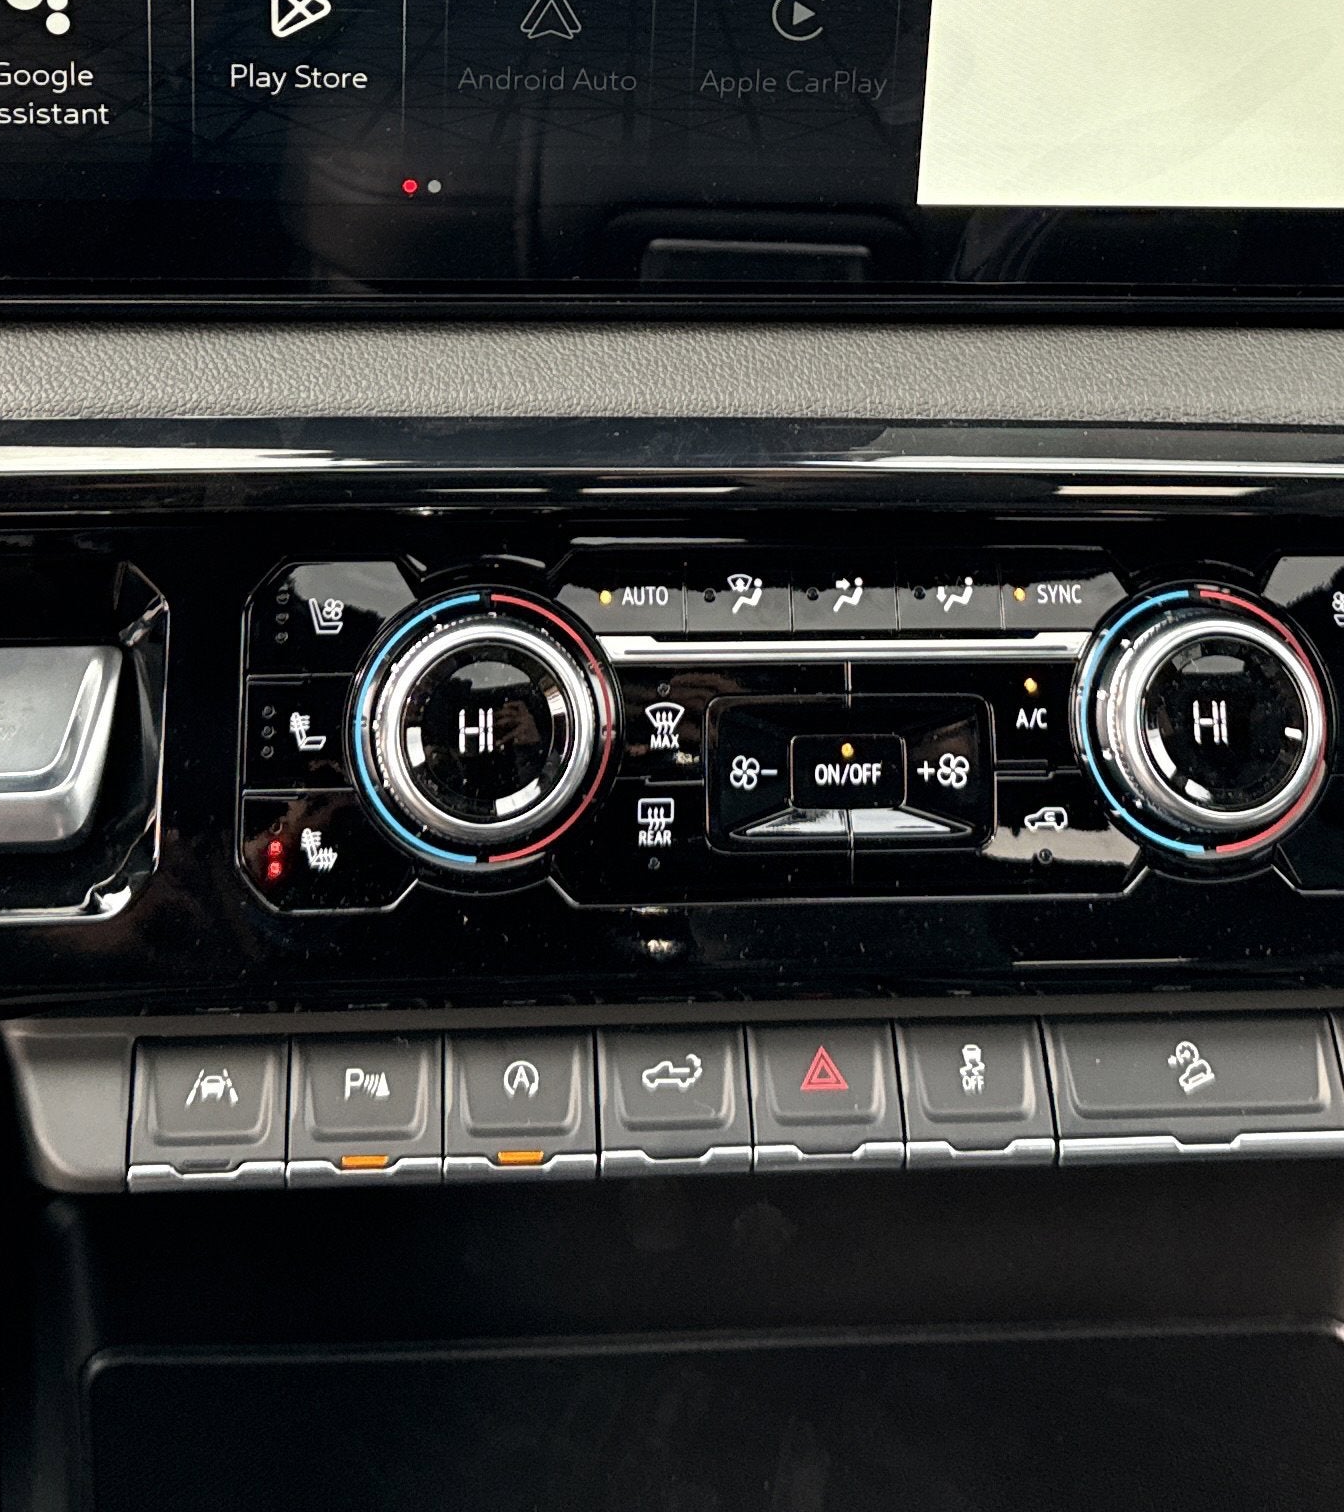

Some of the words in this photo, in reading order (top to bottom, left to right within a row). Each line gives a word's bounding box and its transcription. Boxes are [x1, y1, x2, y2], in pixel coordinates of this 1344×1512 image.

[230, 64, 287, 92] Play
[294, 65, 368, 90] Store
[458, 67, 565, 93] Android
[572, 68, 637, 93] Auto
[700, 69, 777, 99] Apple
[786, 70, 888, 101] CarPlay
[622, 586, 669, 607] AUTO
[1036, 584, 1082, 605] SYNC
[458, 708, 494, 754] HI
[1016, 708, 1048, 731] A/C
[1192, 699, 1229, 746] HI
[650, 734, 680, 750] MAX
[814, 763, 882, 787] ON/OFF
[638, 830, 672, 847] REAR
[962, 1076, 985, 1093] OFF
